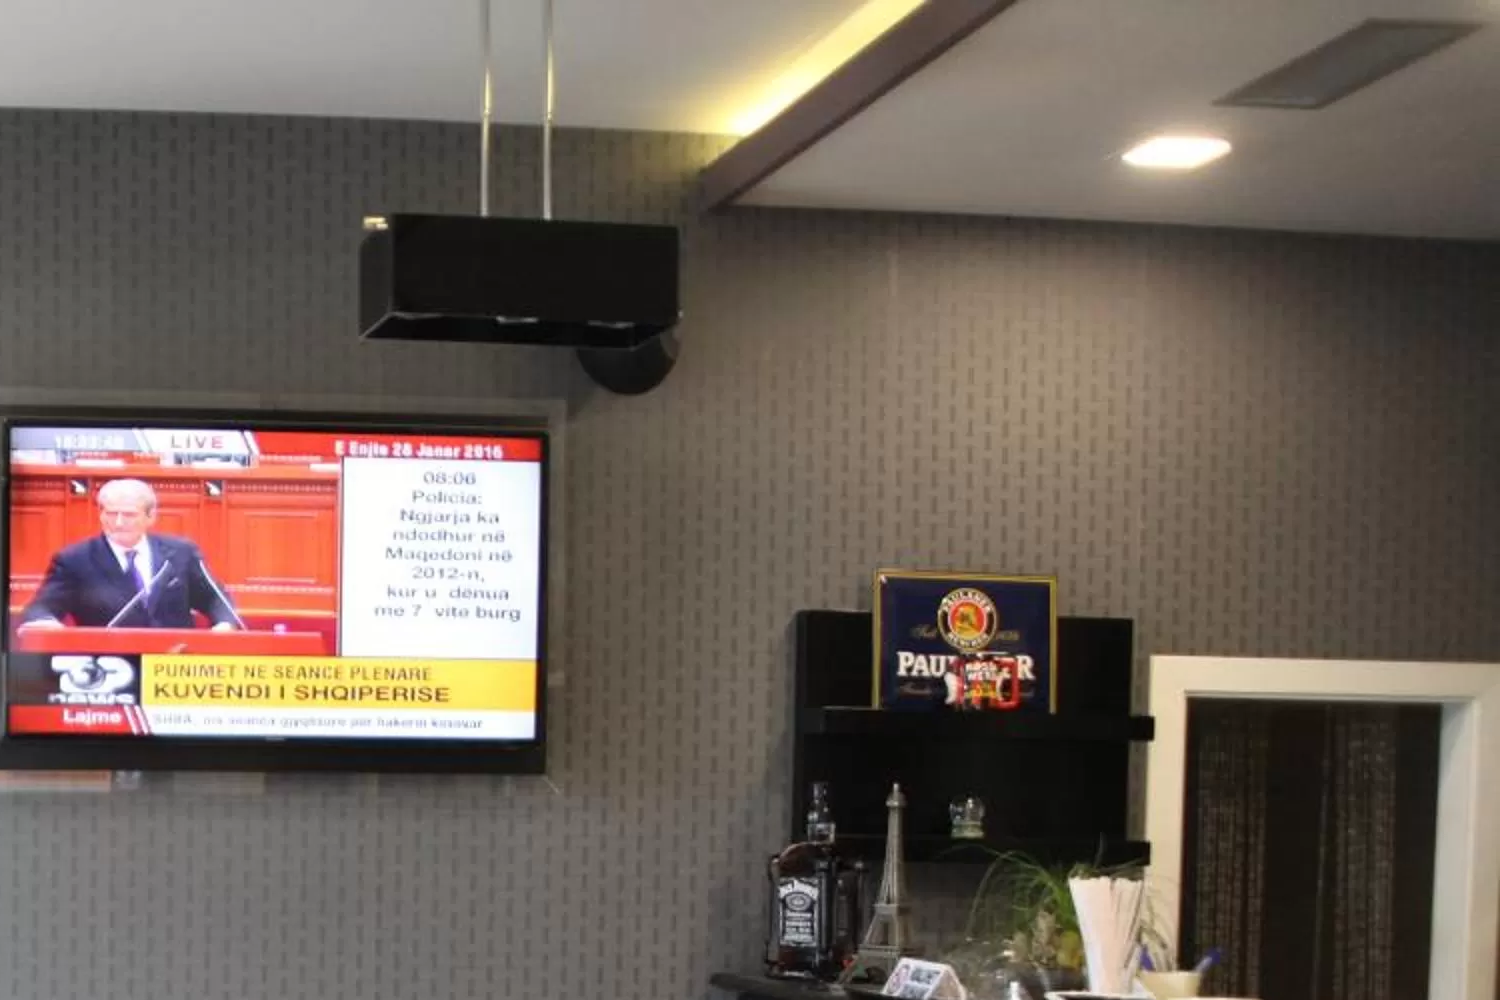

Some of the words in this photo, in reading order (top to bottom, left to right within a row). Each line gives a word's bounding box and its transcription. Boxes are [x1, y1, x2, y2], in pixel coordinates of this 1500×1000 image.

[170, 434, 224, 449] LIVE
[463, 443, 504, 460] 2016
[399, 508, 471, 525] Ngjarja
[476, 511, 500, 525] ka
[392, 527, 475, 542] ndodhur
[384, 547, 483, 563] Maqedoni
[386, 585, 417, 599] kur
[425, 589, 437, 599] u
[373, 606, 405, 617] me
[411, 604, 423, 617] 7
[434, 605, 470, 618] vite
[475, 605, 522, 623] burg
[153, 663, 236, 679] PUNIMET
[273, 664, 344, 681] SEANCE
[349, 666, 433, 682] PLENARE
[153, 683, 271, 700] KUVENDI
[279, 685, 285, 700] I
[294, 684, 450, 703] SHQIPERISE
[62, 707, 123, 728] Lajme
